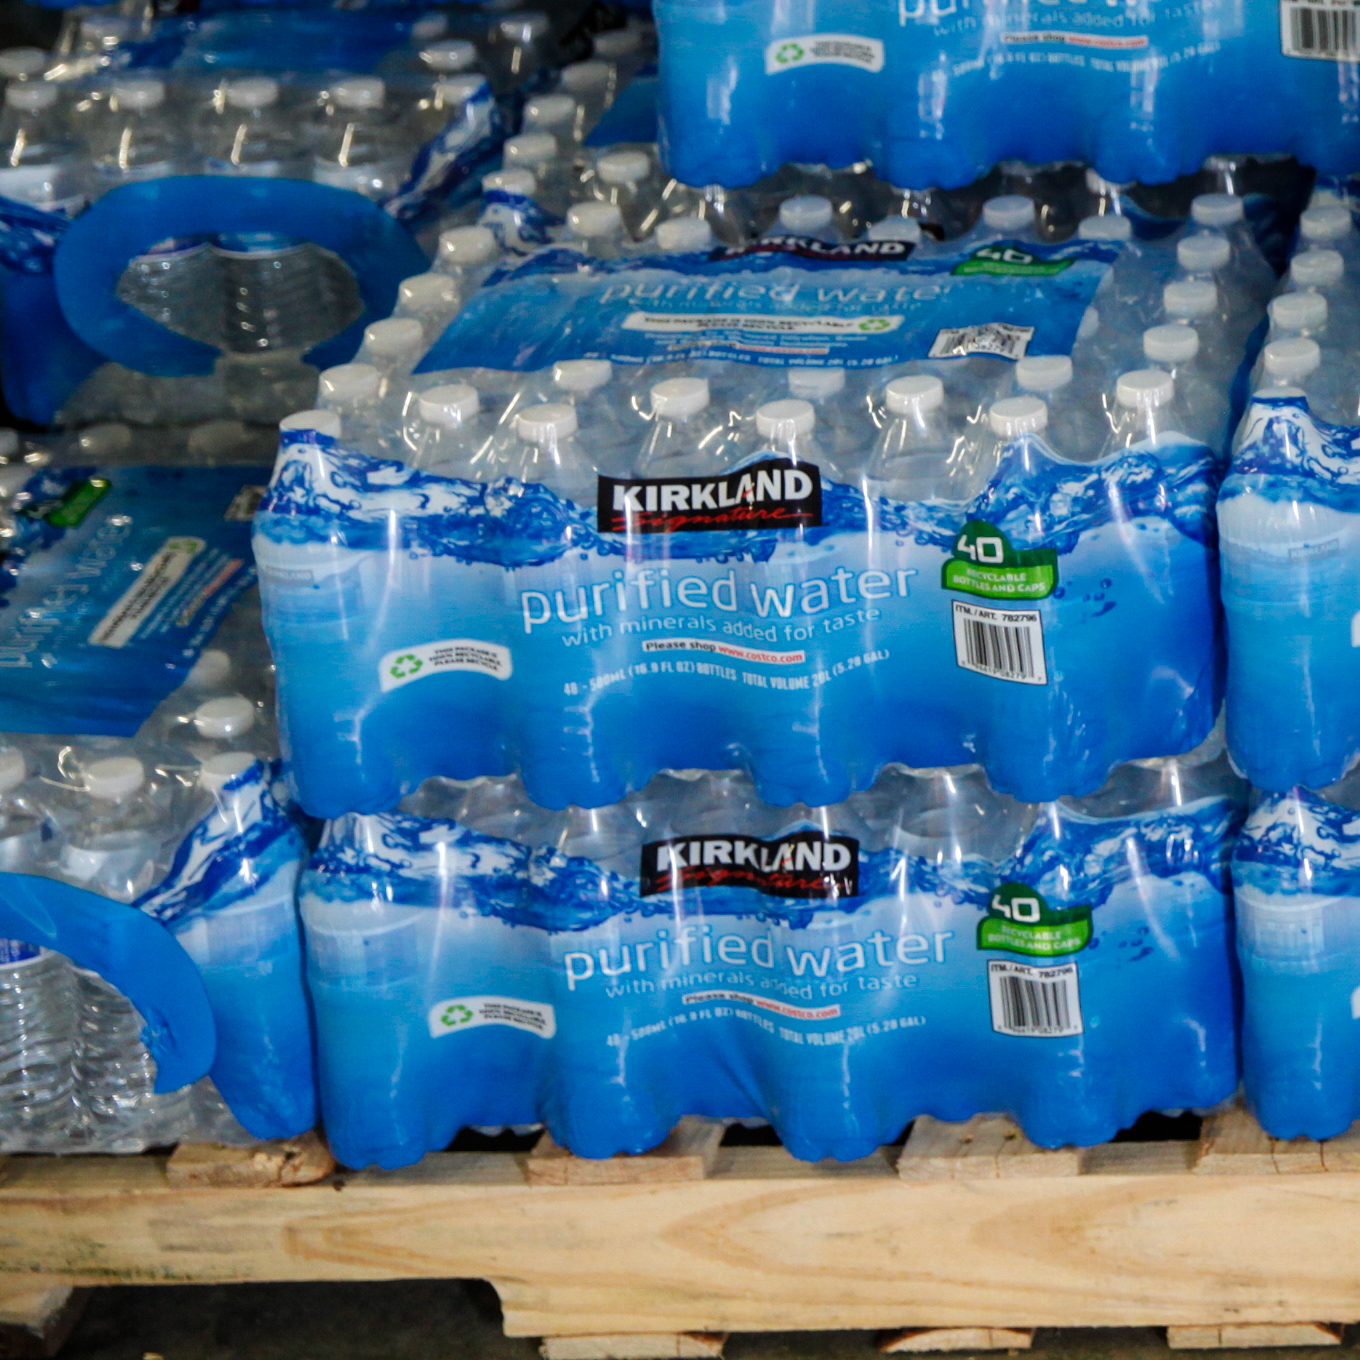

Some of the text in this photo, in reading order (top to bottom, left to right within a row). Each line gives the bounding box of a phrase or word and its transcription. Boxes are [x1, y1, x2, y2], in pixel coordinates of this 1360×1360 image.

[976, 247, 1034, 264] 40
[600, 282, 800, 305] purified
[612, 468, 814, 513] KIRKLAND
[956, 534, 1004, 565] 40
[521, 566, 918, 634] purified water
[991, 582, 1015, 593] AND
[1017, 581, 1047, 593] CAPS
[561, 607, 882, 647] with minerals added for taste
[645, 640, 803, 663] Please shop www.costco.com
[564, 682, 579, 696] 40
[661, 661, 674, 674] FL
[696, 662, 738, 681] BOTTLES
[742, 672, 768, 688] TOTAL
[770, 675, 810, 690] VOLUME
[656, 840, 852, 872] KIRKLAND
[991, 893, 1041, 923] 40
[565, 926, 954, 992] purified water
[605, 977, 655, 999] with
[661, 969, 754, 990] minerals
[819, 979, 849, 998] for
[858, 972, 918, 991] taste
